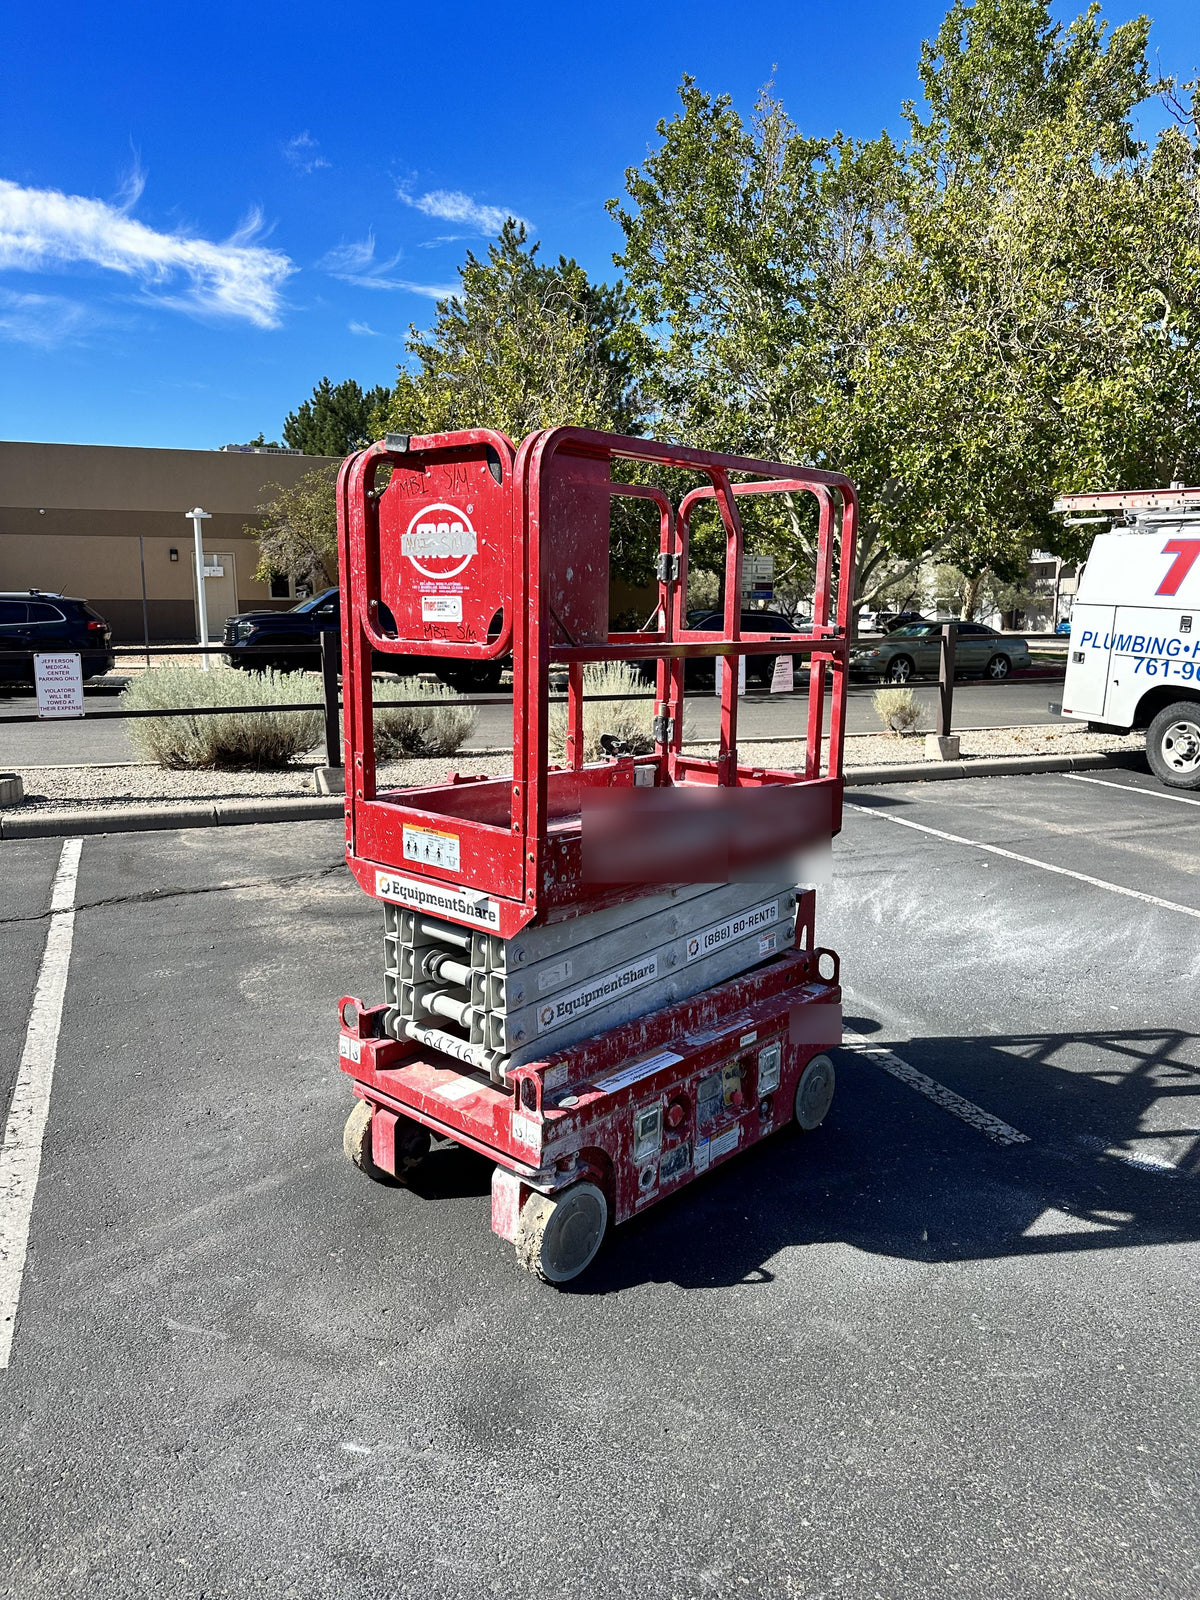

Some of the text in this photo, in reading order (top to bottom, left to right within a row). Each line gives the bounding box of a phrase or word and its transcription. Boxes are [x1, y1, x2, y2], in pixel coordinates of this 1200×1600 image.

[399, 473, 430, 500] MBI
[423, 623, 452, 640] MBI
[392, 881, 496, 923] EquipmentShare
[704, 926, 730, 948] (888)
[733, 906, 776, 934] 80-RENTS
[556, 963, 655, 1018] EquipmentShare
[423, 1031, 474, 1064] 64716
